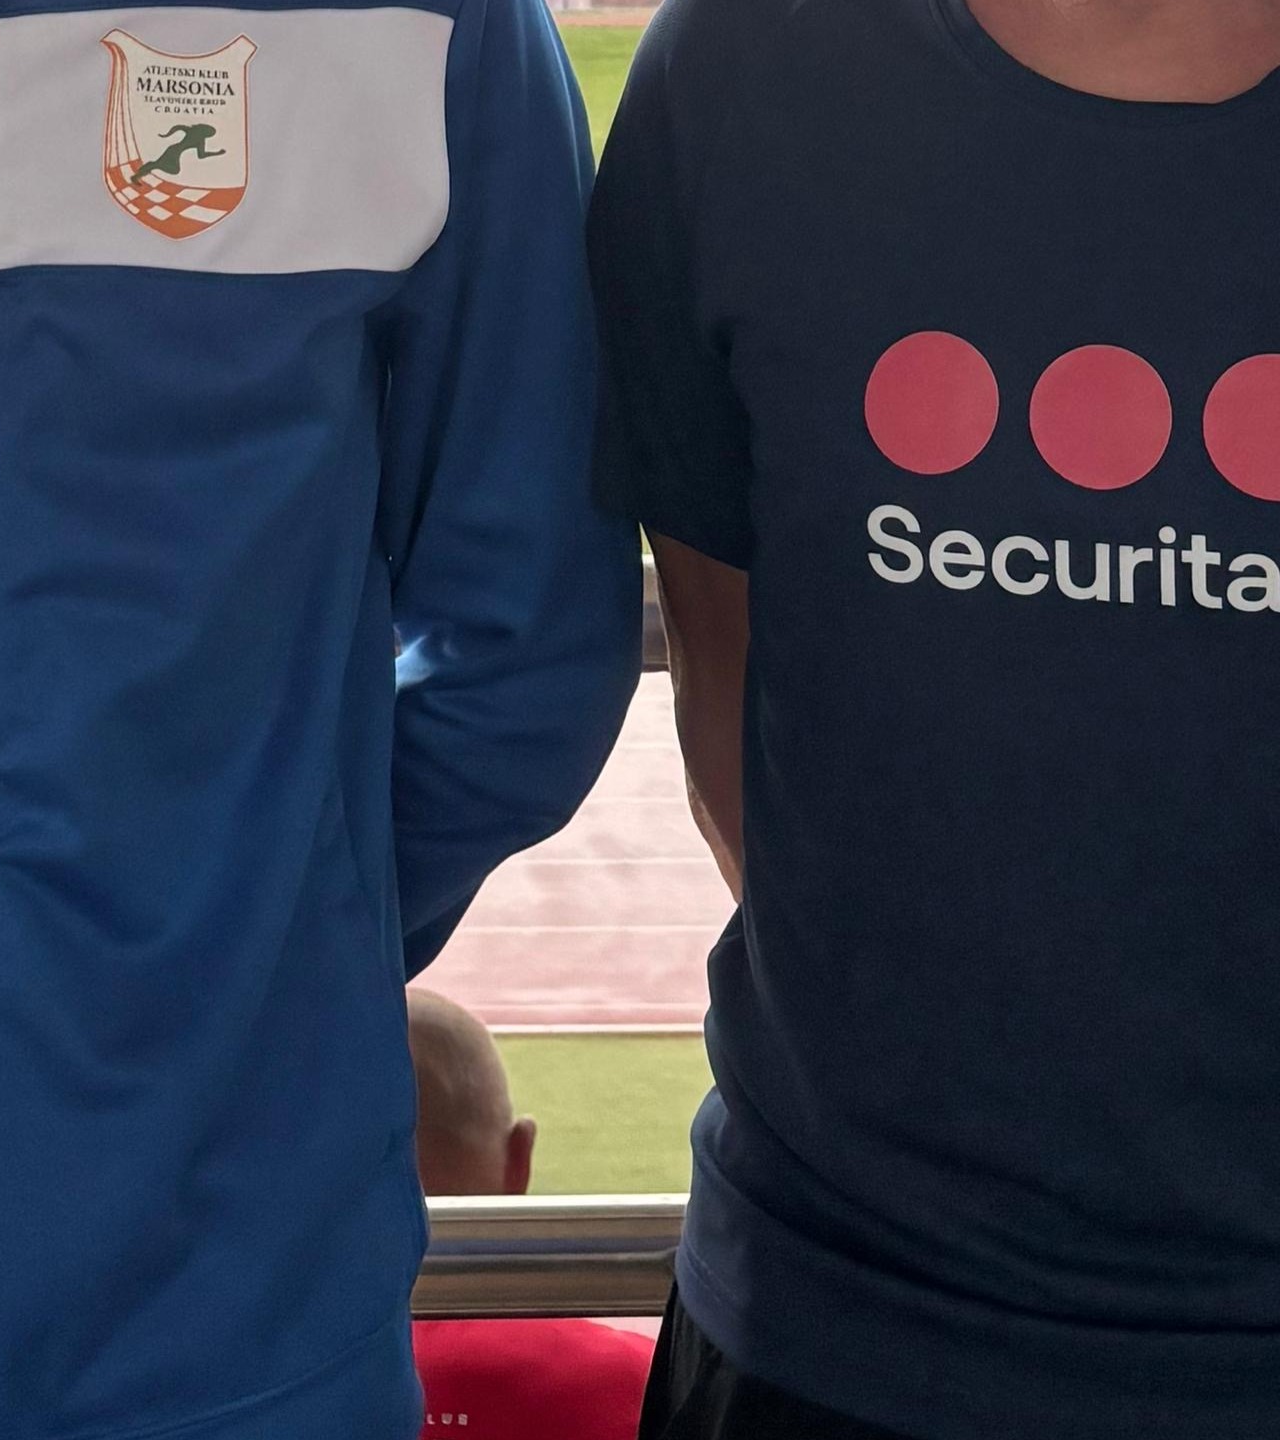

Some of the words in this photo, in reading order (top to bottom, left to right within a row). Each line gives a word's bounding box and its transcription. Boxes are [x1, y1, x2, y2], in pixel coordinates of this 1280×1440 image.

[143, 65, 196, 77] ATLETSKI
[199, 69, 229, 79] KLUB
[136, 76, 235, 96] MARSONIA
[154, 105, 214, 115] CROATIA
